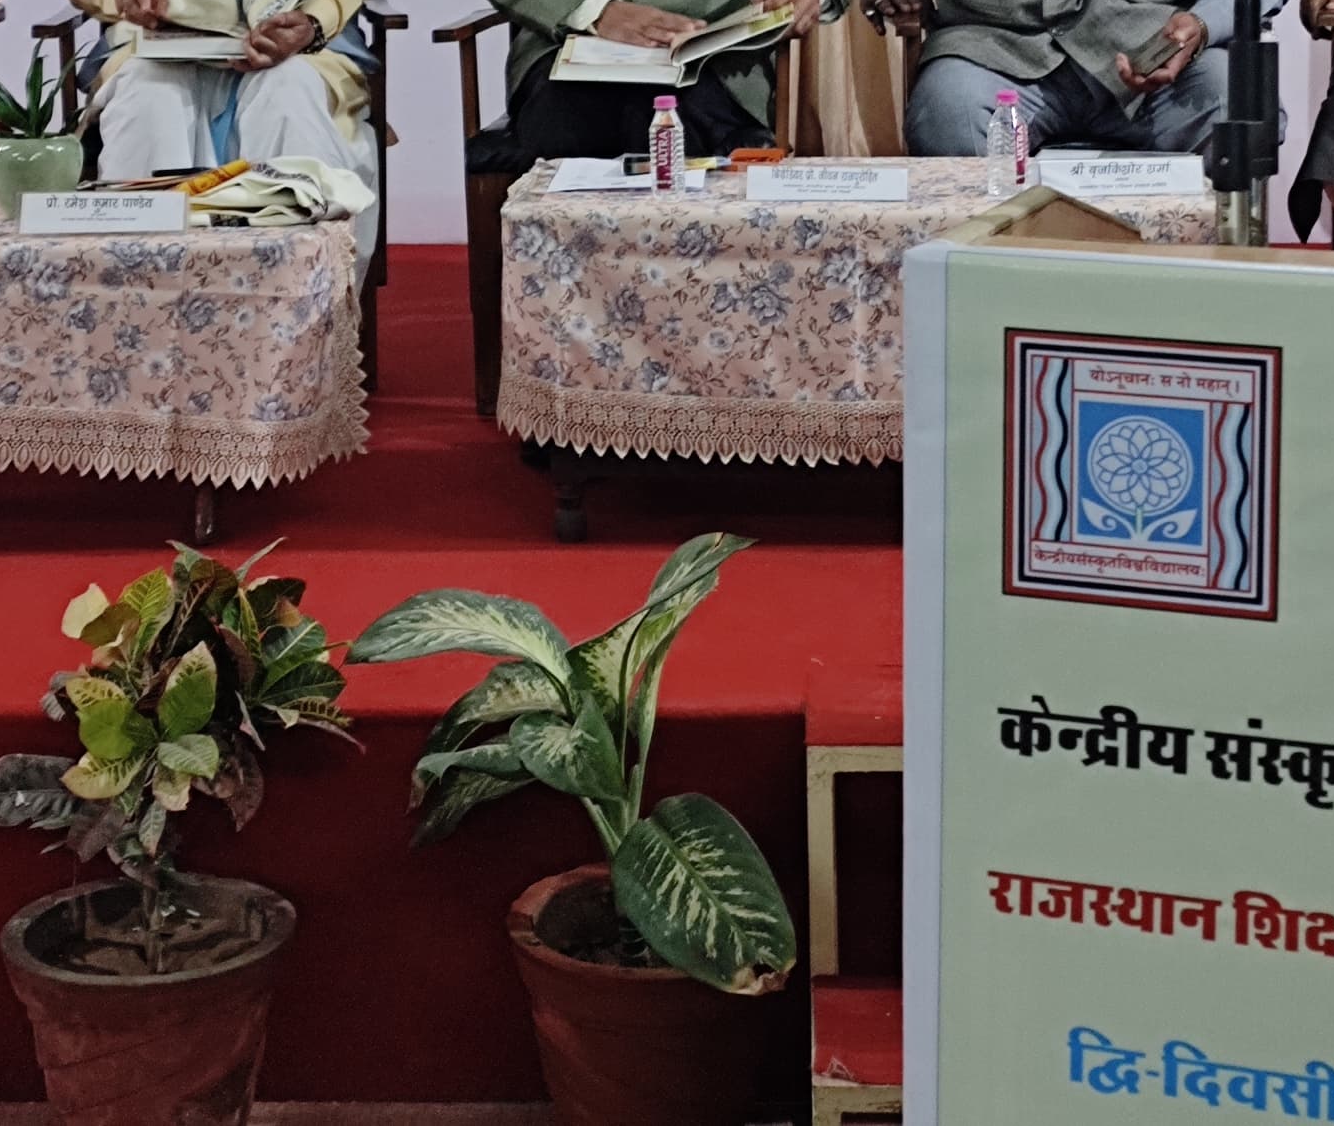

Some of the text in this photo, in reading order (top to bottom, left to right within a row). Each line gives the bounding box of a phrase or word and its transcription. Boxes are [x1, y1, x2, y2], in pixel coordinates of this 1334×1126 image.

[658, 130, 669, 166] ULTRA
[998, 695, 1194, 775] केन्द्रीय
[987, 869, 1221, 943] राजस्थान
